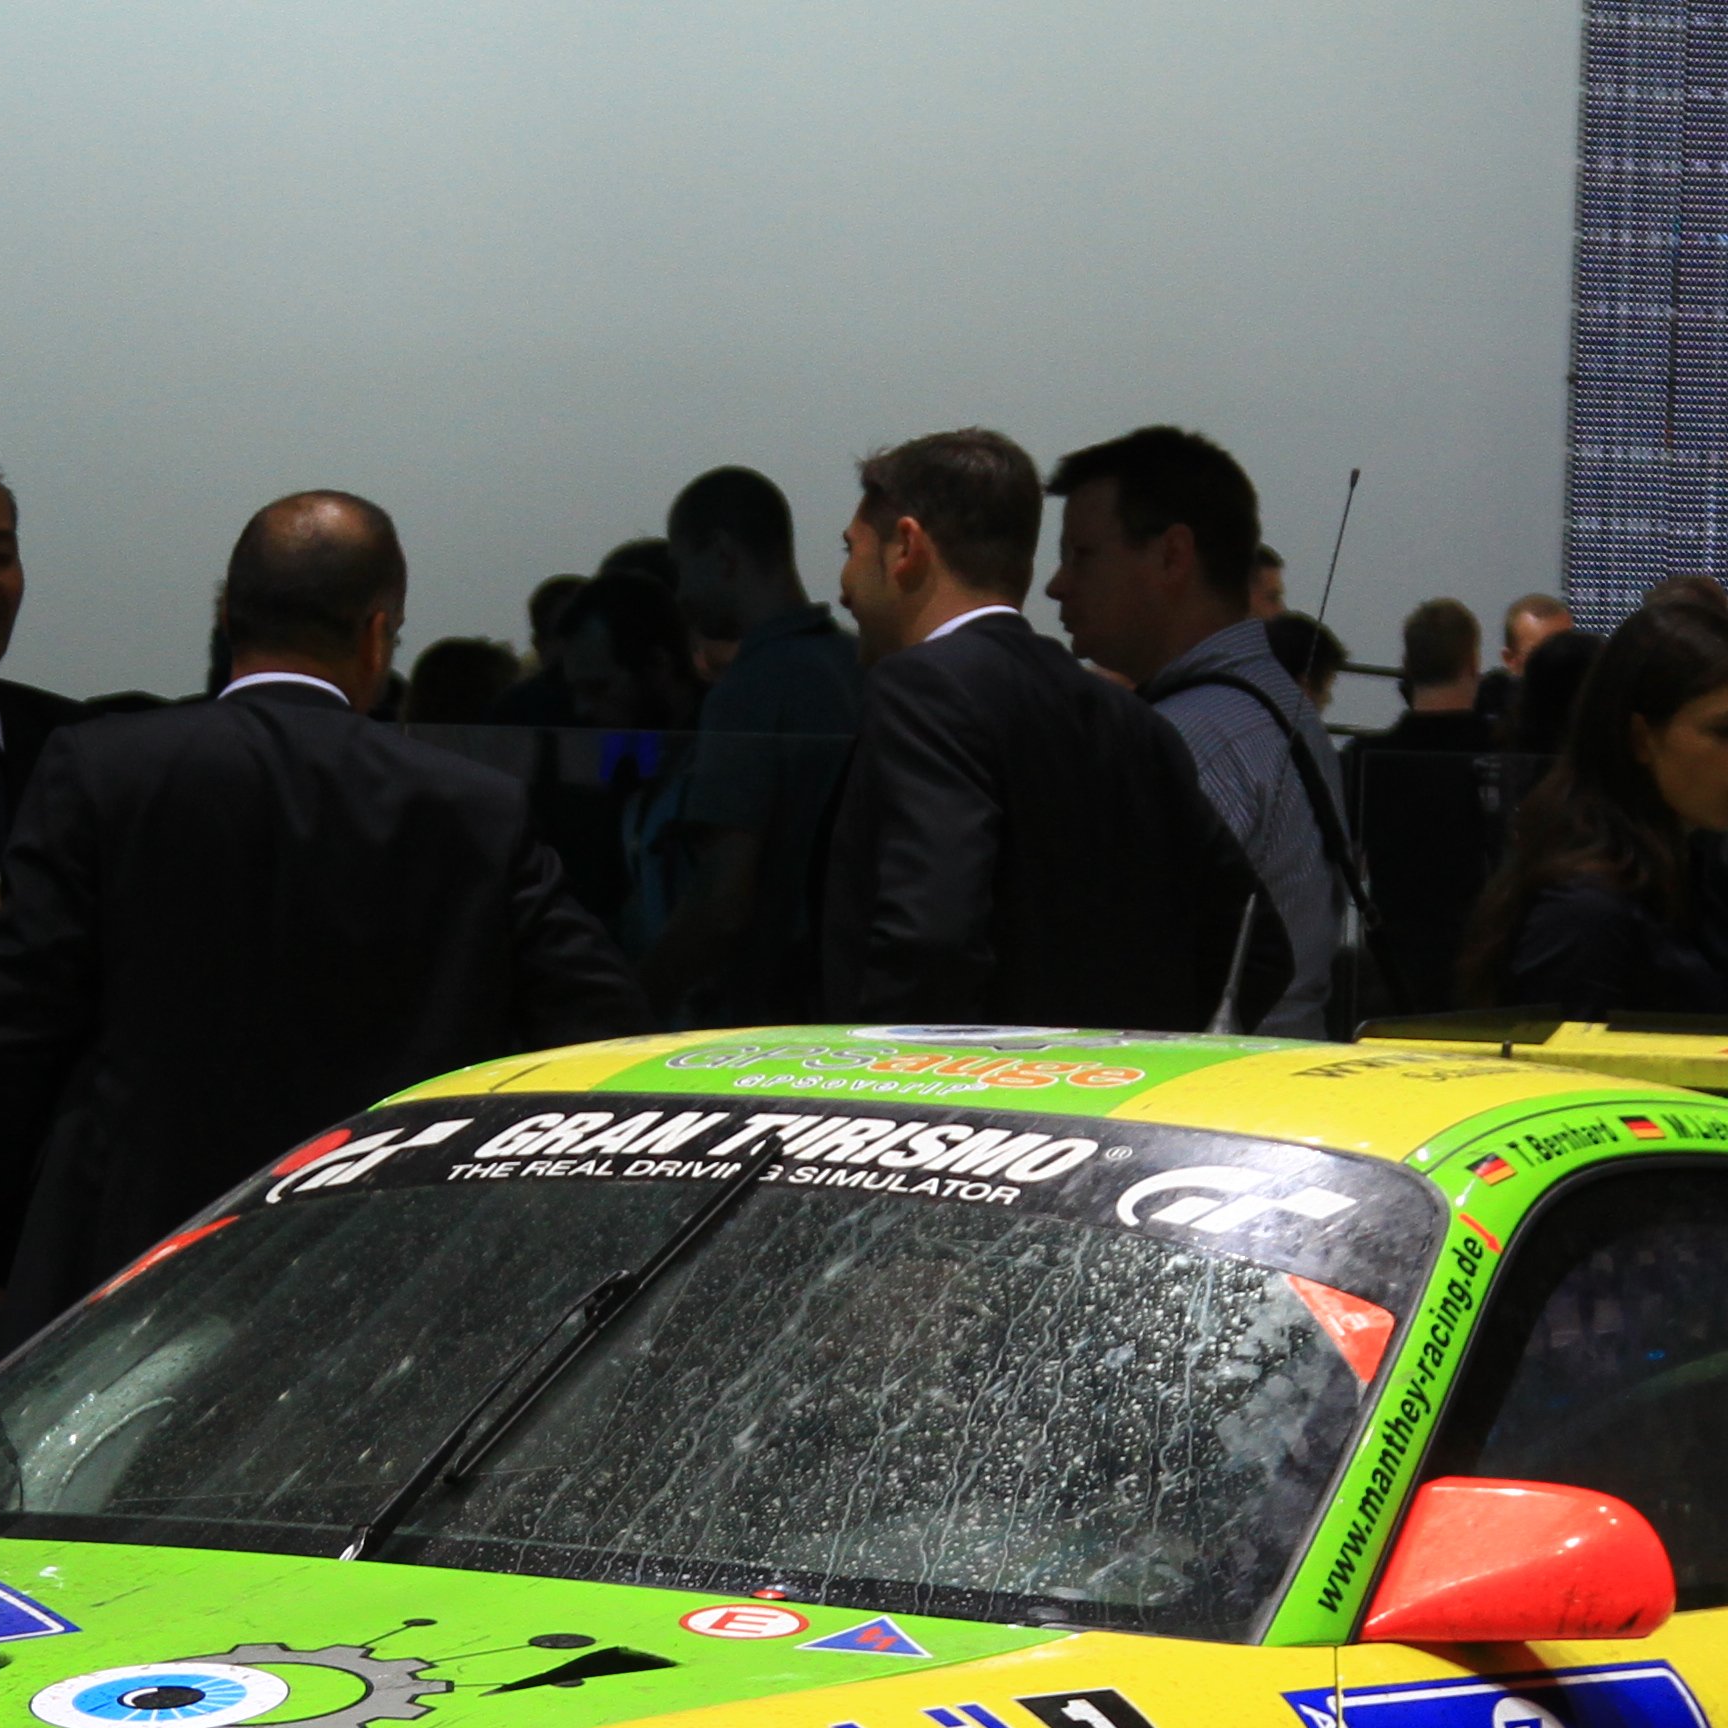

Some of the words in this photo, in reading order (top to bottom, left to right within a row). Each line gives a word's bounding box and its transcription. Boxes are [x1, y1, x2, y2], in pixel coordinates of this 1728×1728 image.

[665, 1043, 1146, 1089] GPSauge
[474, 1110, 731, 1158] GRAN
[706, 1112, 1102, 1182] TURISMO
[446, 1162, 522, 1181] THE
[520, 1159, 615, 1177] REAL
[787, 1166, 1021, 1206] SIMULATOR
[1318, 1234, 1484, 1615] www.manthey-racing.de
